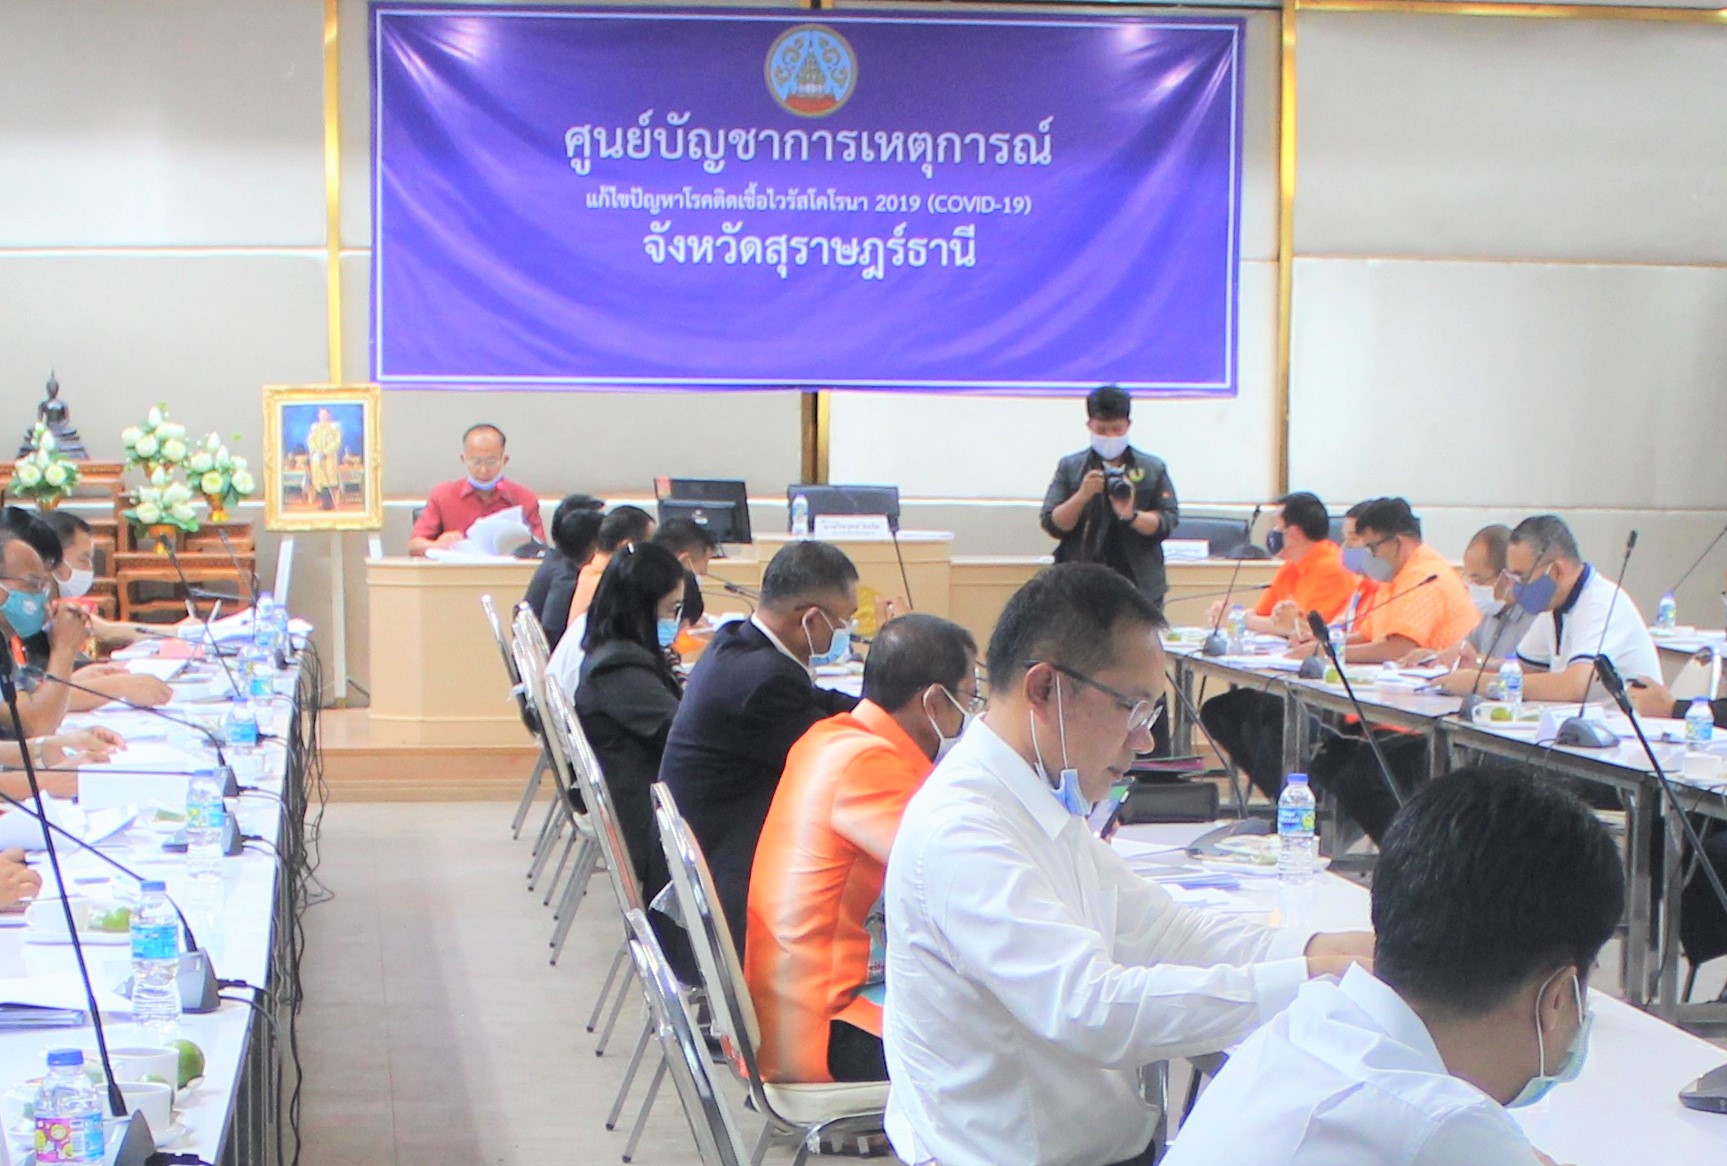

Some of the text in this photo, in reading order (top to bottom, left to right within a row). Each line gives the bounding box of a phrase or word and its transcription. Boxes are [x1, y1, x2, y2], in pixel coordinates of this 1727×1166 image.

[564, 111, 1053, 178] ศูนย์บัญชาการเหตุการณ์
[875, 194, 921, 213] 2019
[927, 194, 1032, 215] (COVID-19)
[643, 220, 976, 279] จังหวัดสุราษฎร์ธานี
